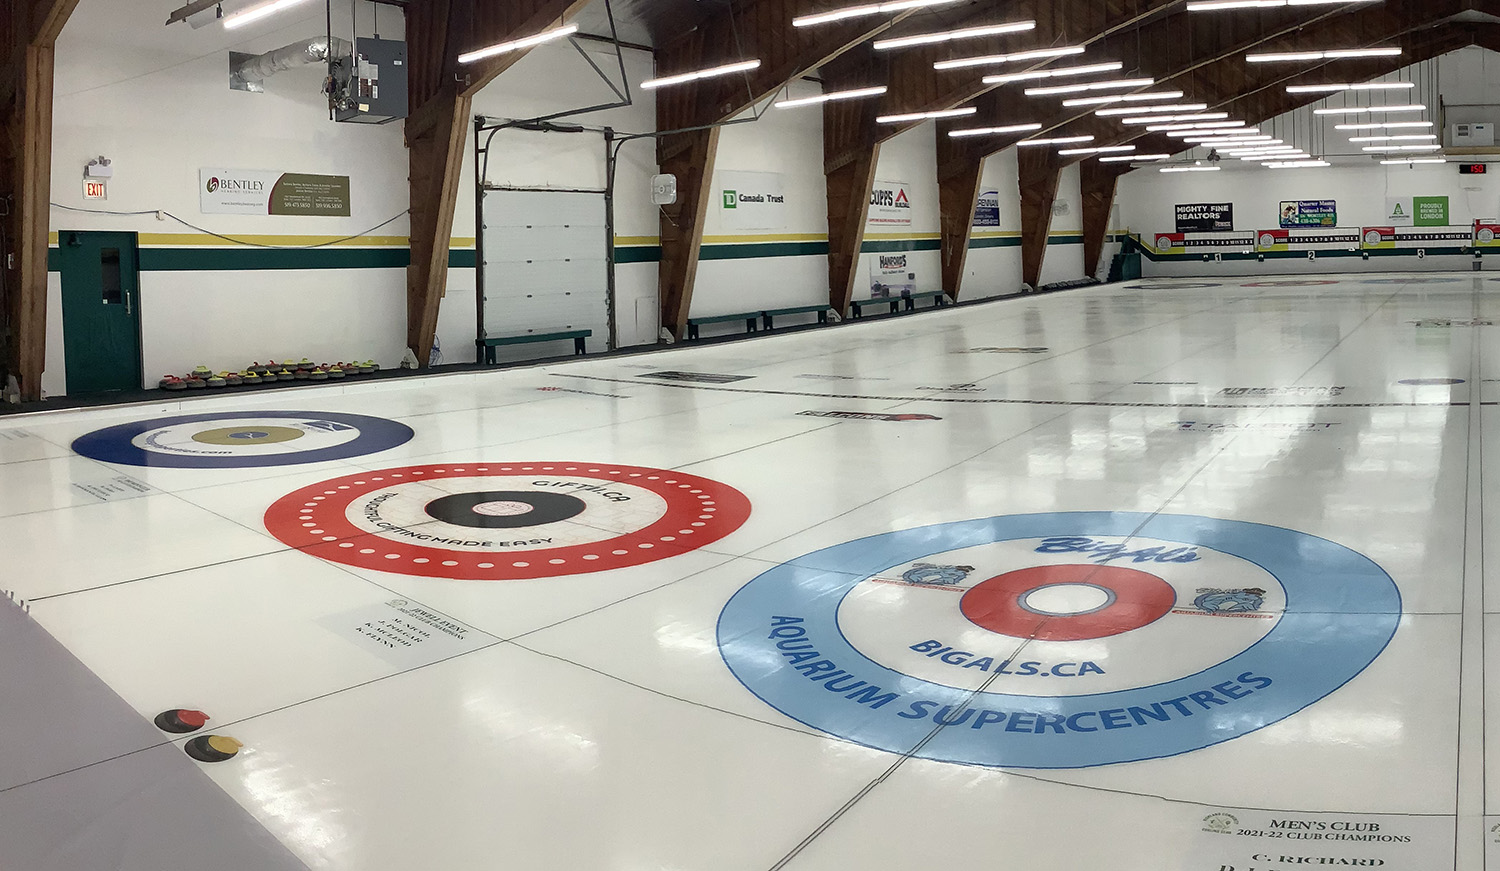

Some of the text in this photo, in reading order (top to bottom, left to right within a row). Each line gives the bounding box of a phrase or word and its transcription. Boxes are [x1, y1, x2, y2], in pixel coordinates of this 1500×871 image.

[88, 183, 104, 196] EXIT
[220, 180, 264, 190] BENTLEY
[739, 194, 764, 202] Canada
[767, 194, 784, 203] Trust
[870, 190, 892, 206] COPPS
[376, 522, 434, 540] GIFTING
[430, 537, 493, 548] MADE
[500, 537, 554, 548] EASY
[908, 639, 1106, 678] BIGALS.CA
[767, 615, 1273, 734] AQUARIUM SUPERCENTRES
[1269, 819, 1380, 832] MEN'S CLUB
[1236, 829, 1411, 843] 2021-22 CLUB CHAMPIONS
[1252, 853, 1385, 866] C. RICHARD
